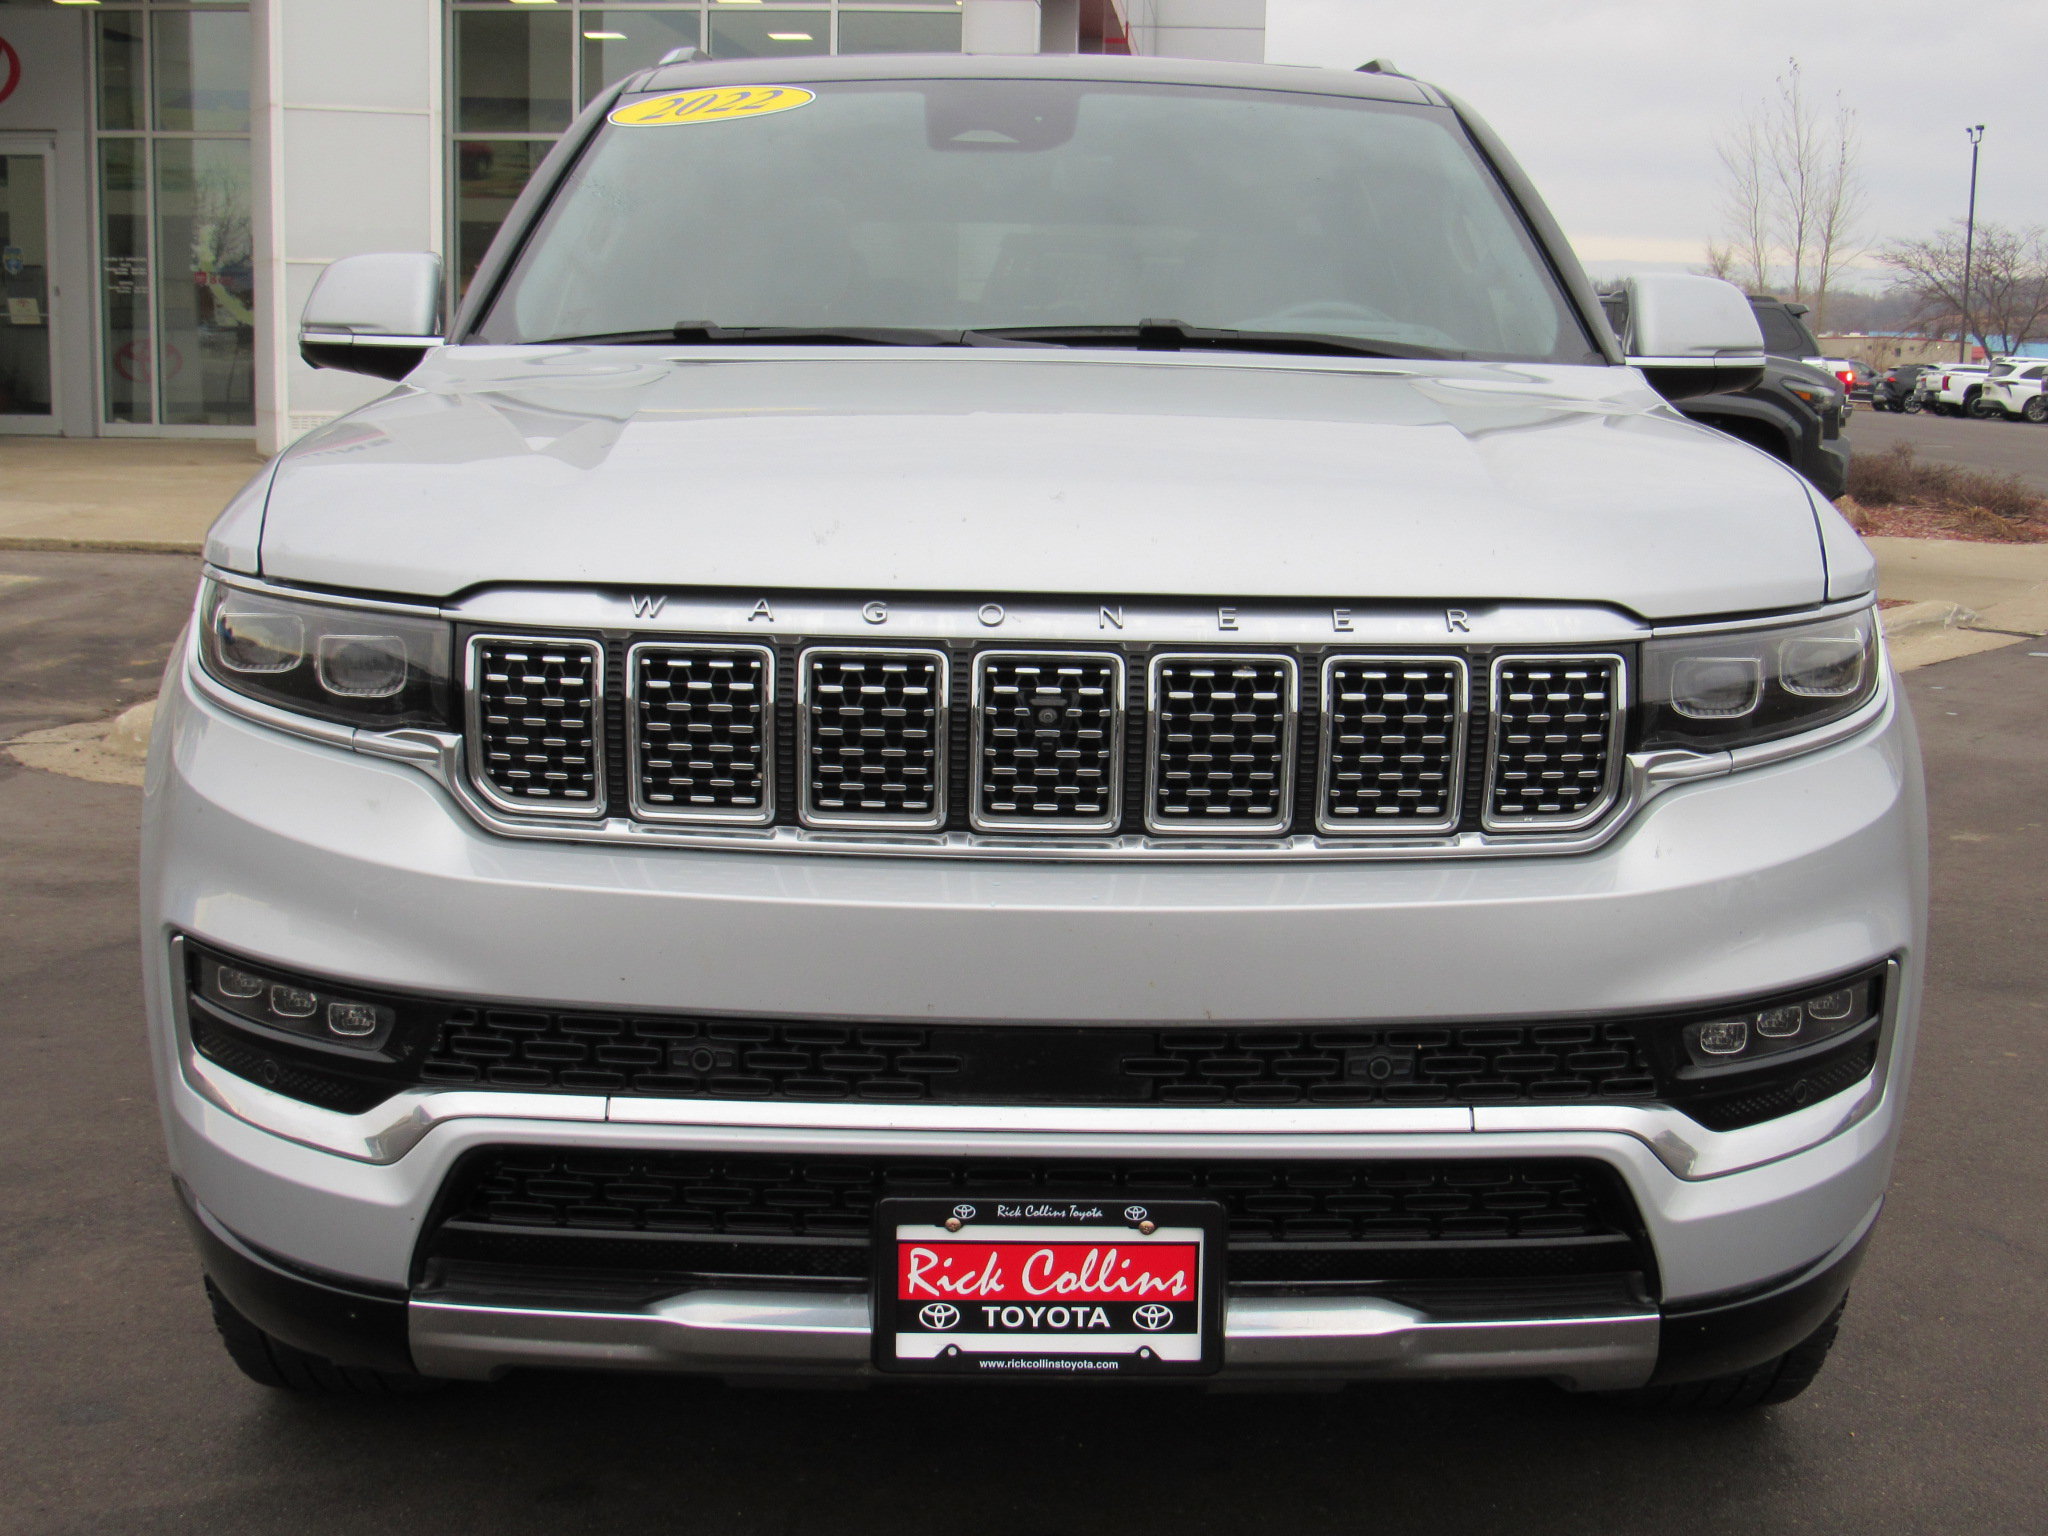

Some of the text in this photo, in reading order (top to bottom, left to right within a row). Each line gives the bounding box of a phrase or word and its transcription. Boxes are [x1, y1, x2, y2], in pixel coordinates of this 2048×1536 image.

[636, 89, 784, 121] 2022
[631, 594, 1471, 633] WAGONEER
[996, 1204, 1103, 1221] Rick Collins Toyota
[907, 1247, 1187, 1297] Rick Collins
[981, 1306, 1111, 1328] TOYOTA
[979, 1359, 1119, 1371] www.rickcollinstoyota.com
